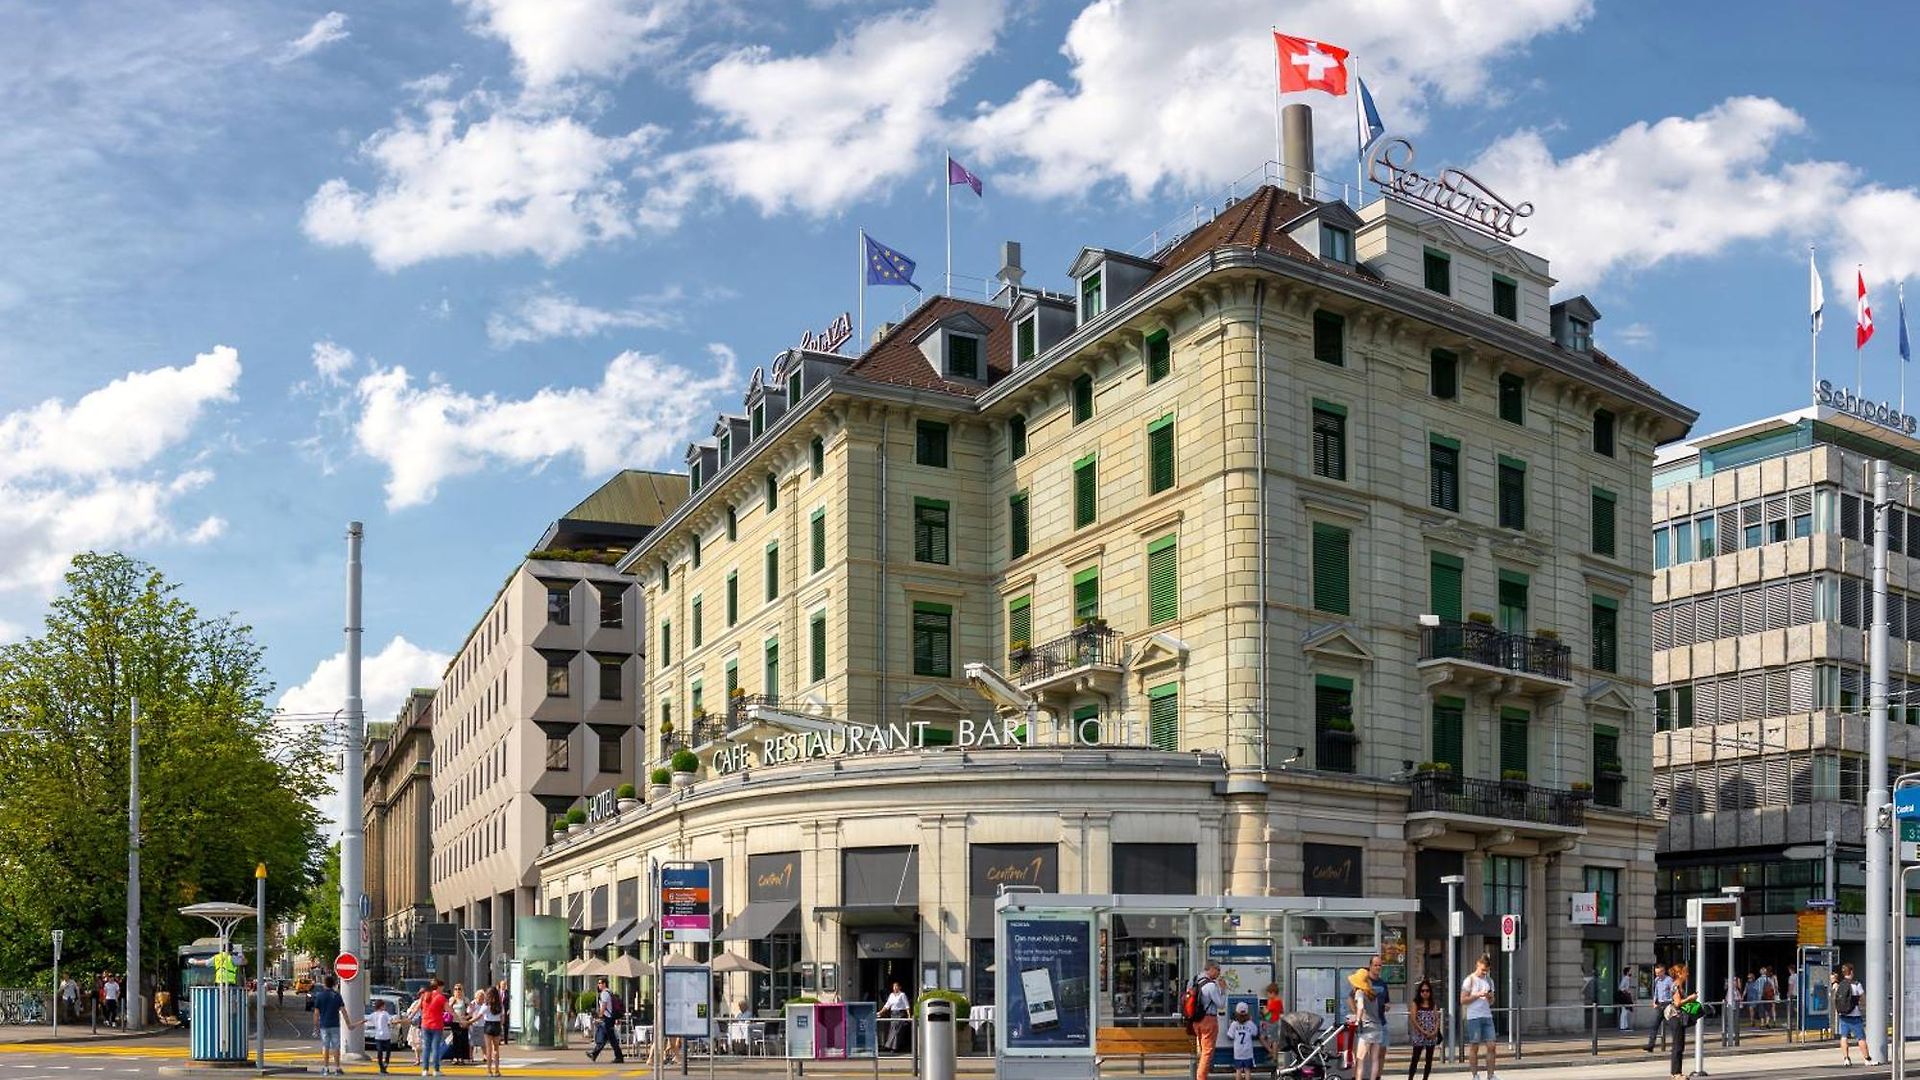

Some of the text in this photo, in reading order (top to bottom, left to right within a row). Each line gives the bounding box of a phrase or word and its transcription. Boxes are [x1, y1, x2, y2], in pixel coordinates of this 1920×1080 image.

[1368, 136, 1534, 238] Central
[1814, 379, 1918, 435] Schroders
[764, 721, 934, 764] RESTAURANT
[958, 718, 1022, 747] BAR
[589, 788, 616, 823] HOTEL
[1238, 1031, 1246, 1045] 7
